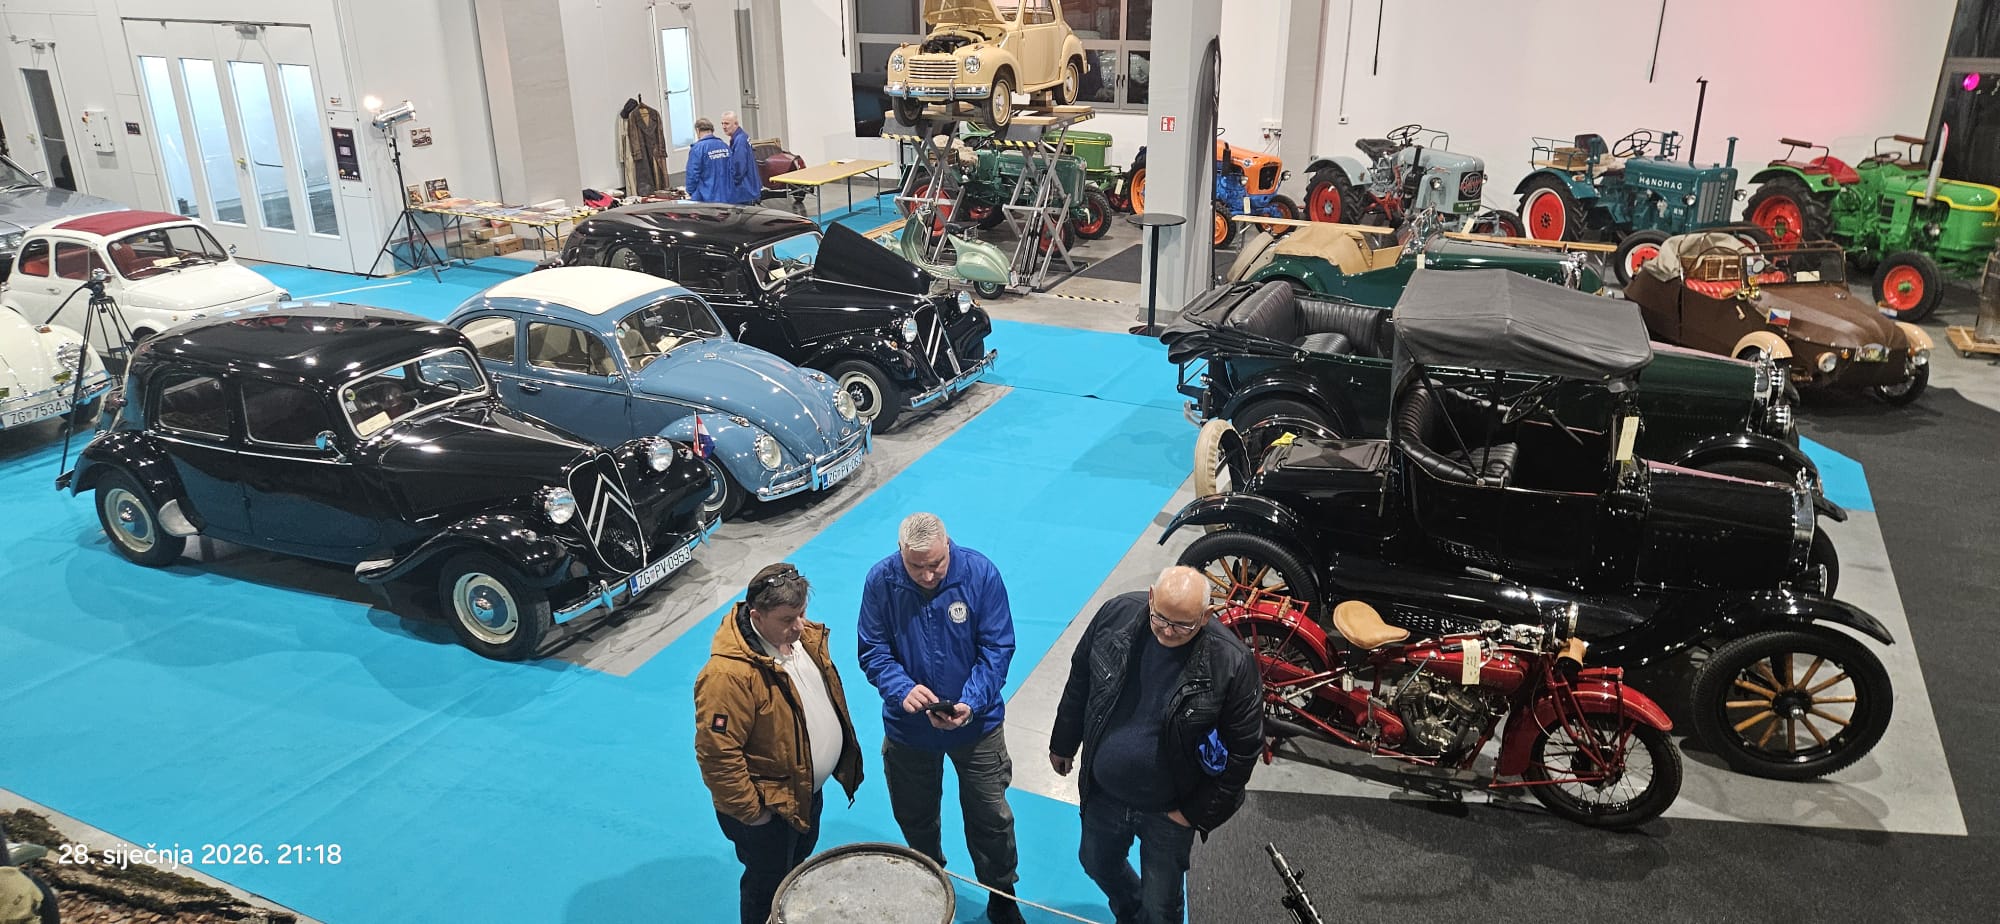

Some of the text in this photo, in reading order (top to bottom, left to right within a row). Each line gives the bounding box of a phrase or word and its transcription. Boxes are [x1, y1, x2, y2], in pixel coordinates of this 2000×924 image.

[1639, 176, 1683, 190] HANOMAG
[9, 411, 26, 425] ZG
[828, 470, 838, 484] ZG
[637, 571, 651, 588] ZG
